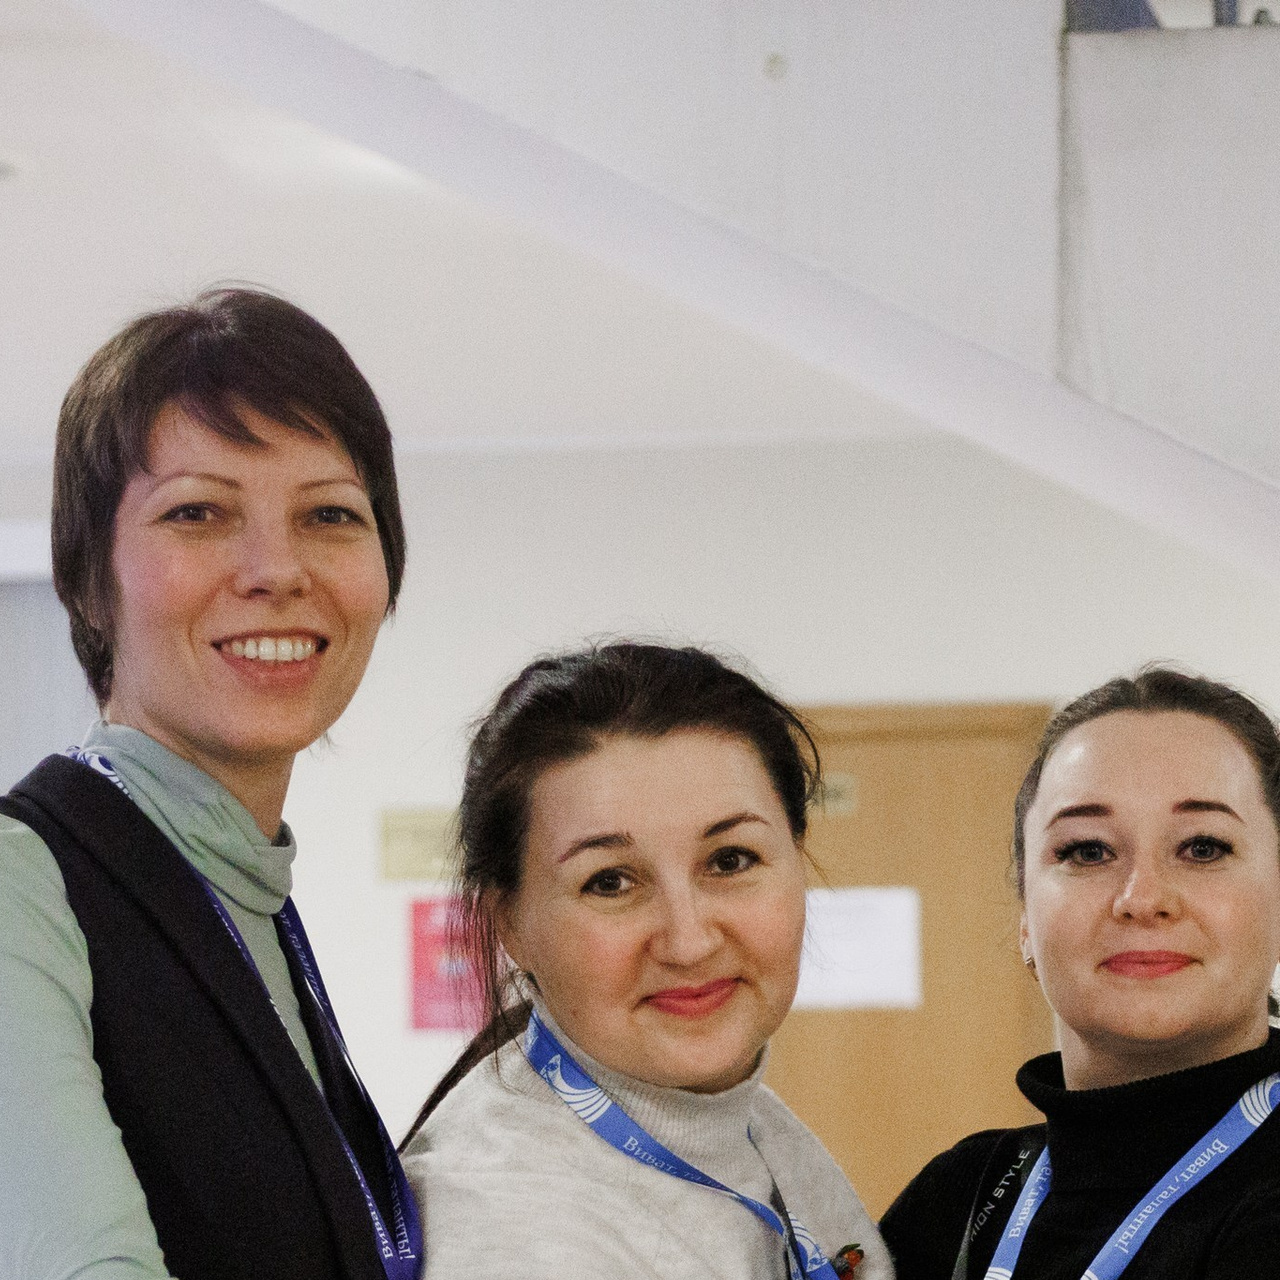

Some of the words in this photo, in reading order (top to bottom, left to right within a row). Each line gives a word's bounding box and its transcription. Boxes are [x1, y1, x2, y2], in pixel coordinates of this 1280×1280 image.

[622, 1136, 677, 1175] Виват,
[992, 1149, 1030, 1198] STYLE
[1175, 1138, 1230, 1182] Виват,
[1008, 1184, 1044, 1239] Виват,
[1114, 1184, 1181, 1254] таланты!
